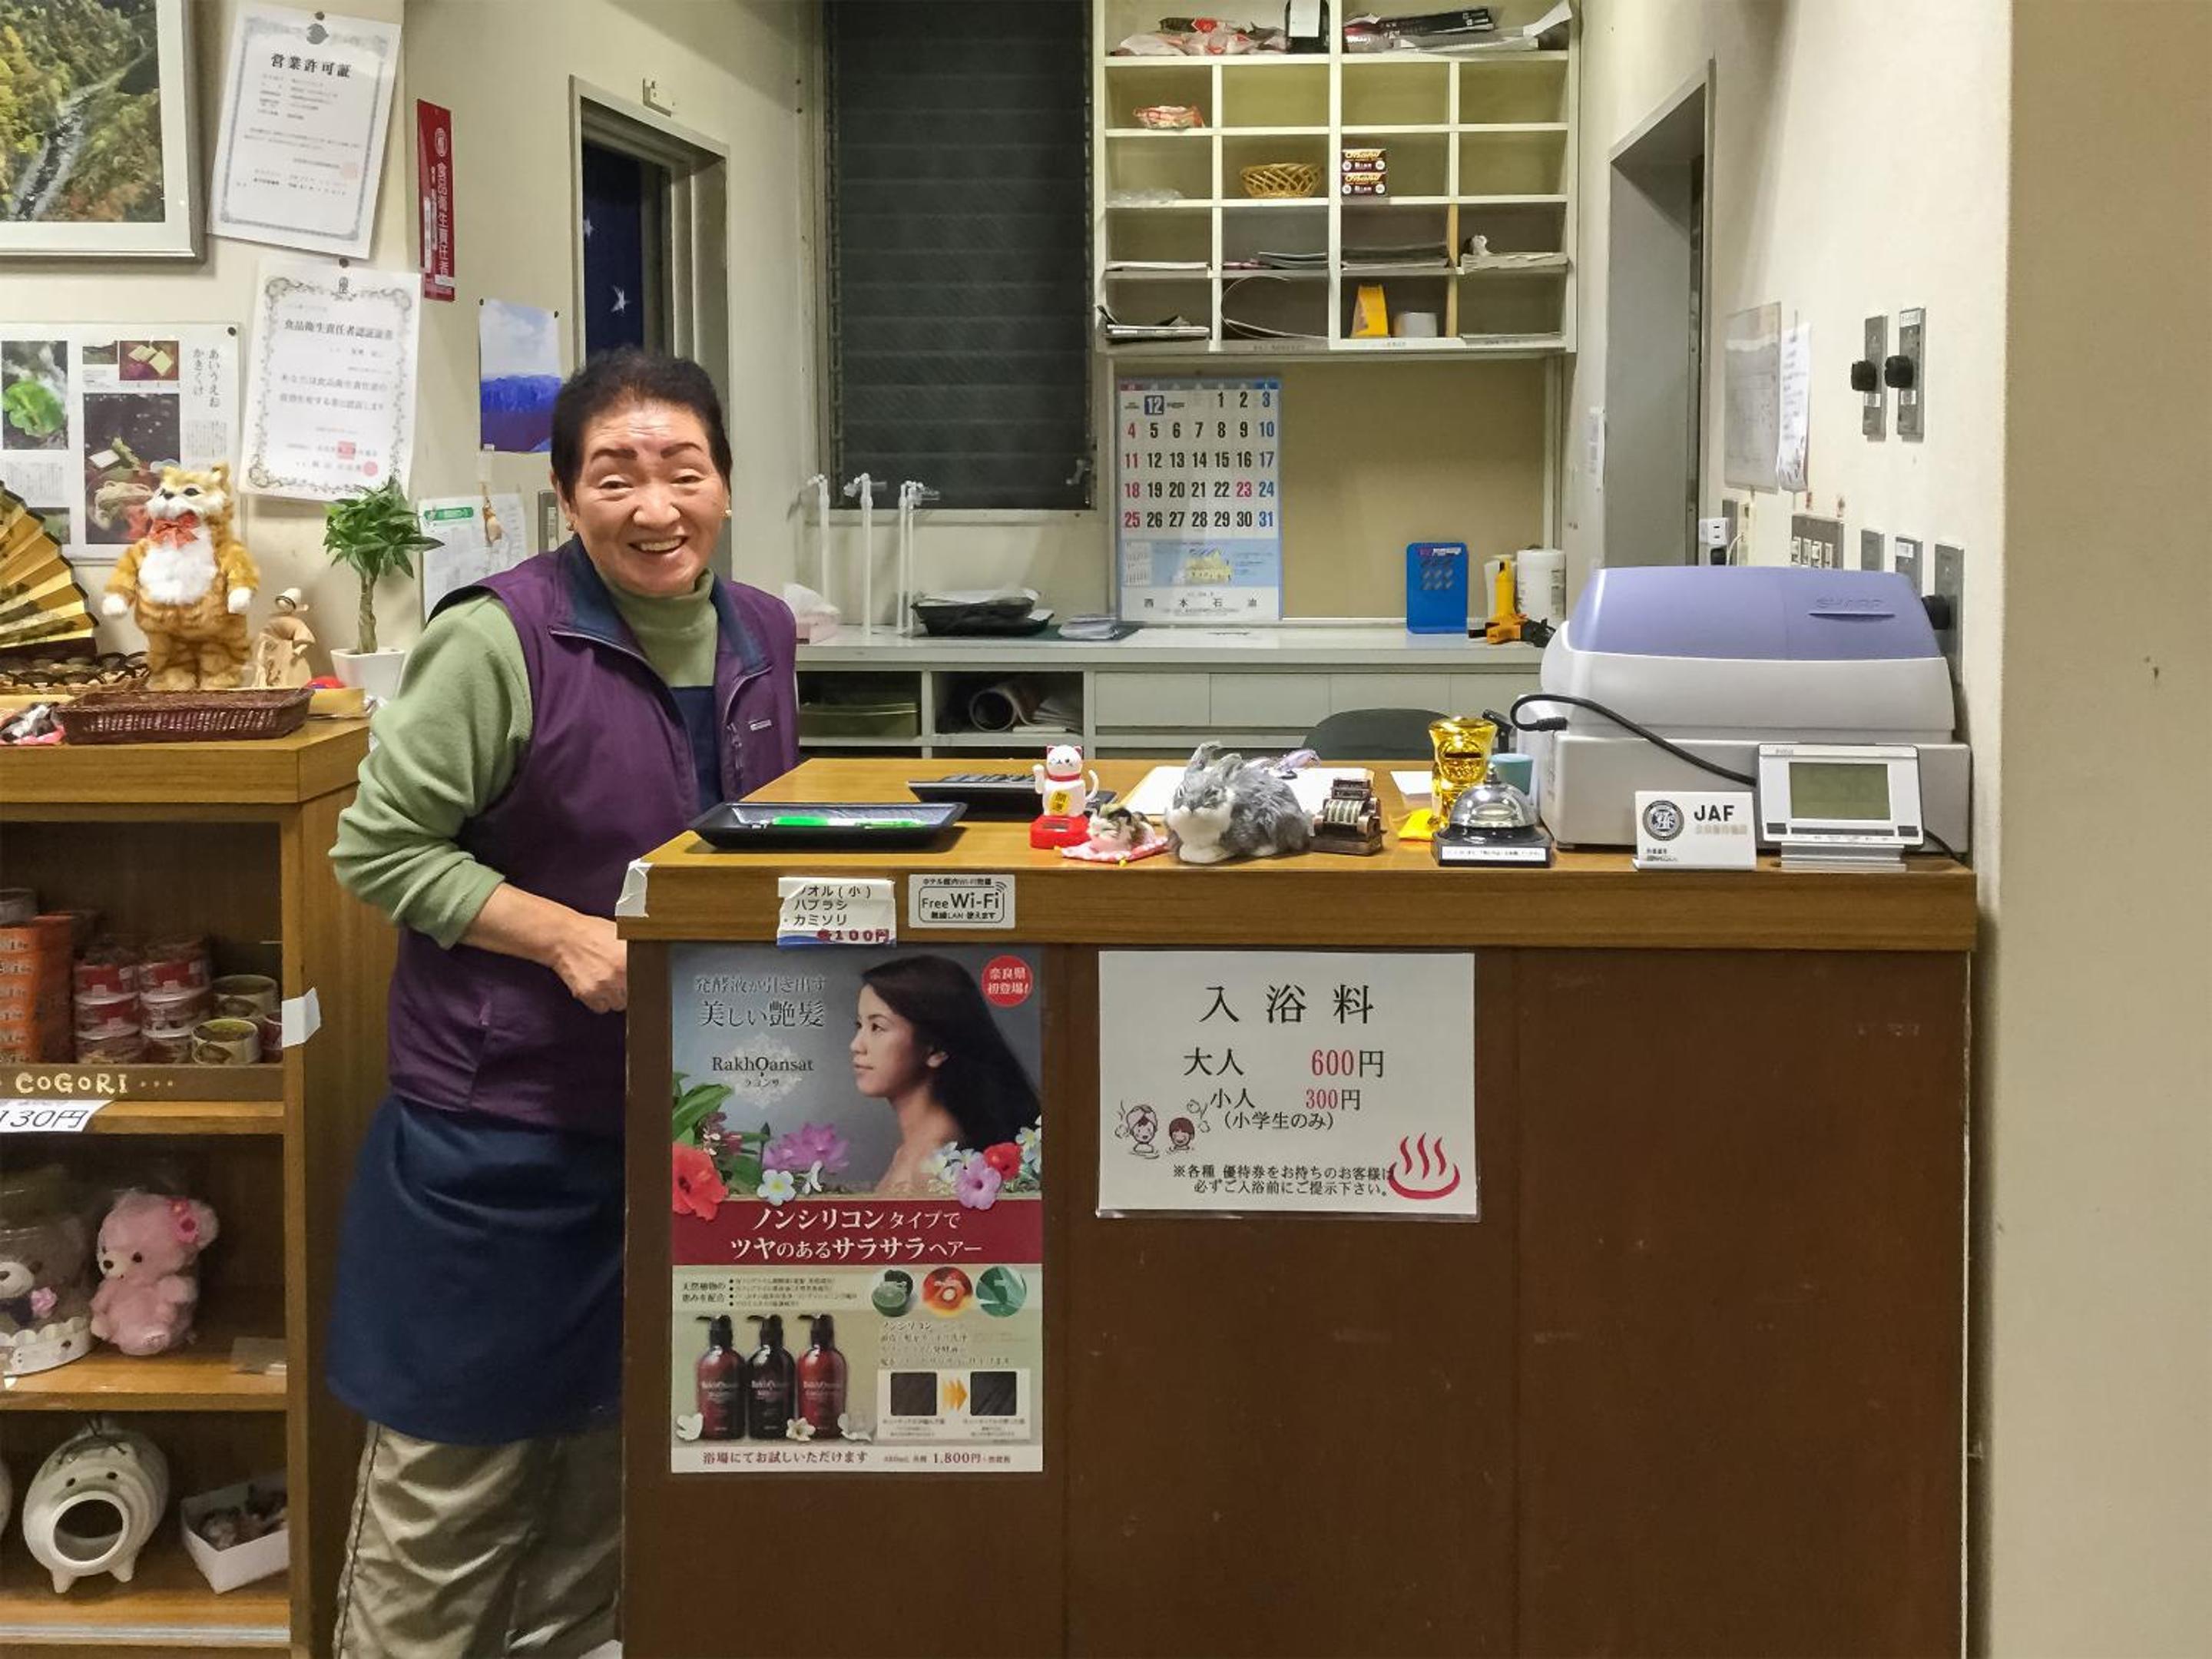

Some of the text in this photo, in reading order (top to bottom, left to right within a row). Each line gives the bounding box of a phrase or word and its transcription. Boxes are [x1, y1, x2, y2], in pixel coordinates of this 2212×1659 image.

[1147, 397, 1163, 414] 12
[1218, 392, 1270, 408] 1 2 3
[1128, 422, 1274, 438] 4 5 6 7 8 9 10
[1125, 452, 1274, 469] 11 12 13 14 15 16 17
[1125, 482, 1274, 498] 18 19 20 21 22 23 24
[1124, 512, 1273, 528] 25 26 27 28 29 30 31
[1694, 804, 1735, 822] JAF
[922, 892, 999, 909] Free Wi-Fi
[793, 913, 848, 926] カミソリ
[989, 967, 1026, 979] 奈良県
[1199, 984, 1374, 1025] 入浴料
[700, 1001, 826, 1028] 美しい艶髪
[1184, 1047, 1384, 1078] 大人 600円
[1210, 1088, 1360, 1111] 小人 300円
[1224, 1111, 1334, 1131] (小学生のみ)
[730, 1237, 982, 1260] ツヤのあるサラサラヘアー
